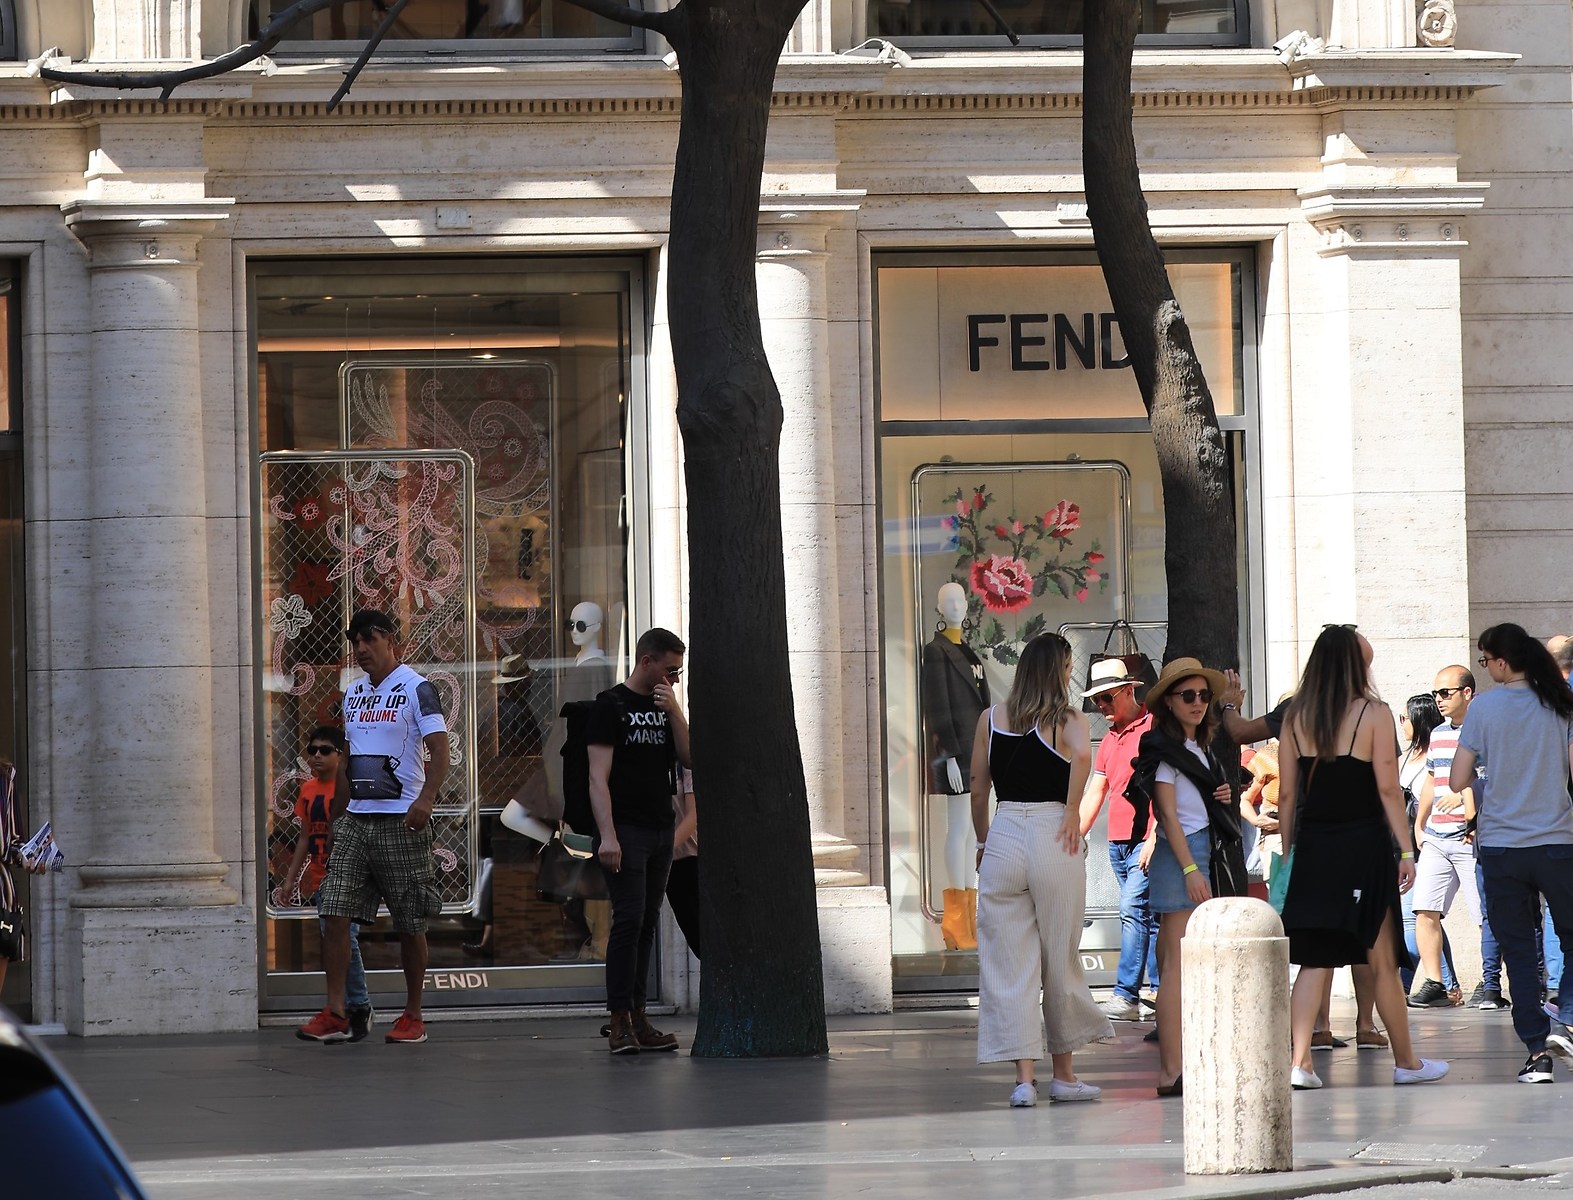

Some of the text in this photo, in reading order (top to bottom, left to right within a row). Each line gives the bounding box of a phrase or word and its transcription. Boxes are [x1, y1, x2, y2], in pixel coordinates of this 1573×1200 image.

[967, 312, 1132, 371] FEND
[348, 694, 407, 710] PUMP UP
[359, 709, 398, 722] VOLUME
[625, 729, 666, 745] MARS
[422, 973, 489, 989] FENDI
